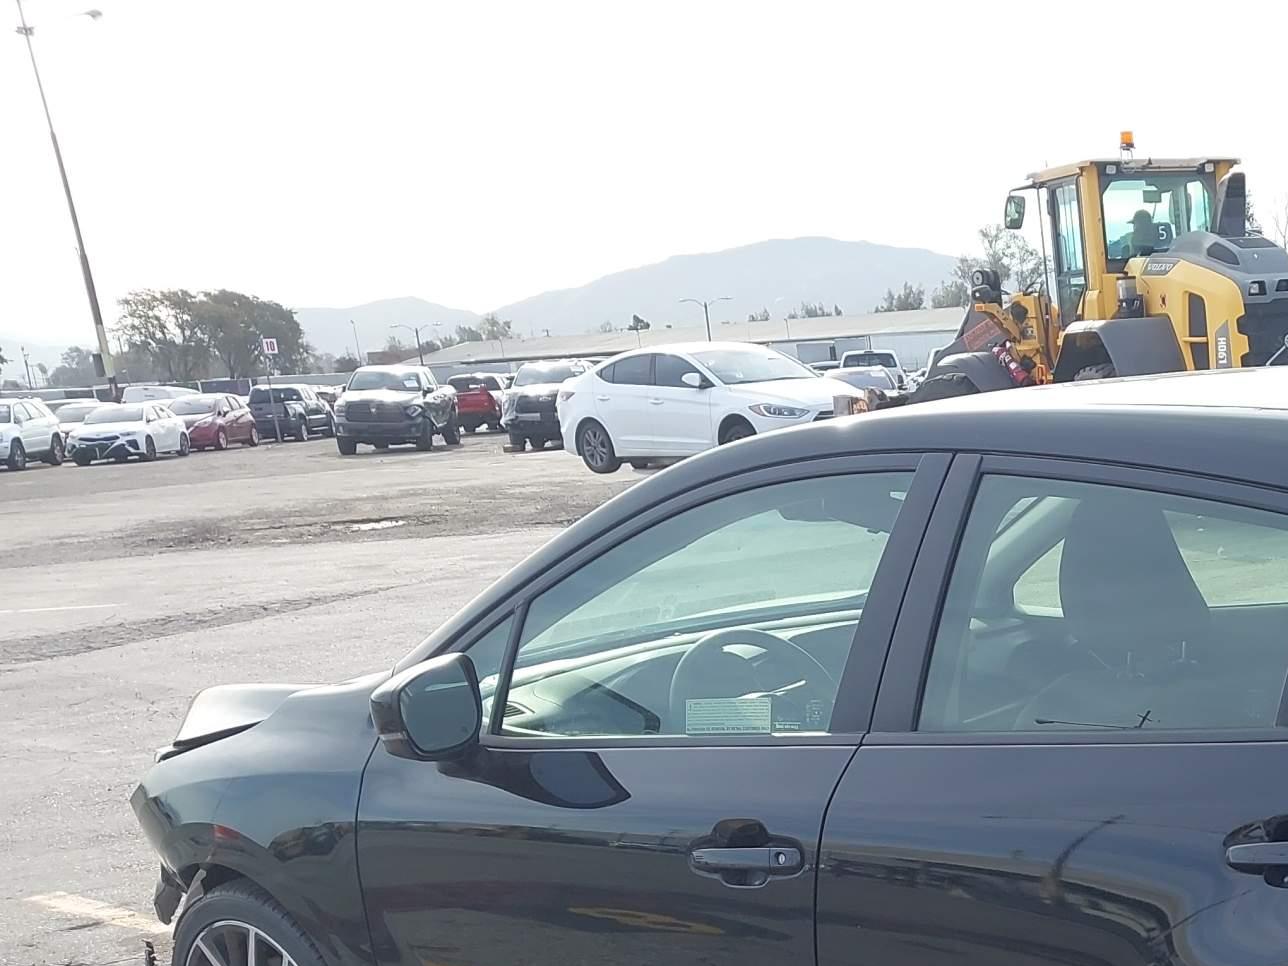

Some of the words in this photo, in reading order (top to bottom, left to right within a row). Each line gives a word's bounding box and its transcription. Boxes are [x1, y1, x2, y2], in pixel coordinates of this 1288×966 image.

[1147, 263, 1174, 271] VOLVO
[265, 340, 276, 352] 10
[1217, 336, 1228, 364] L90H
